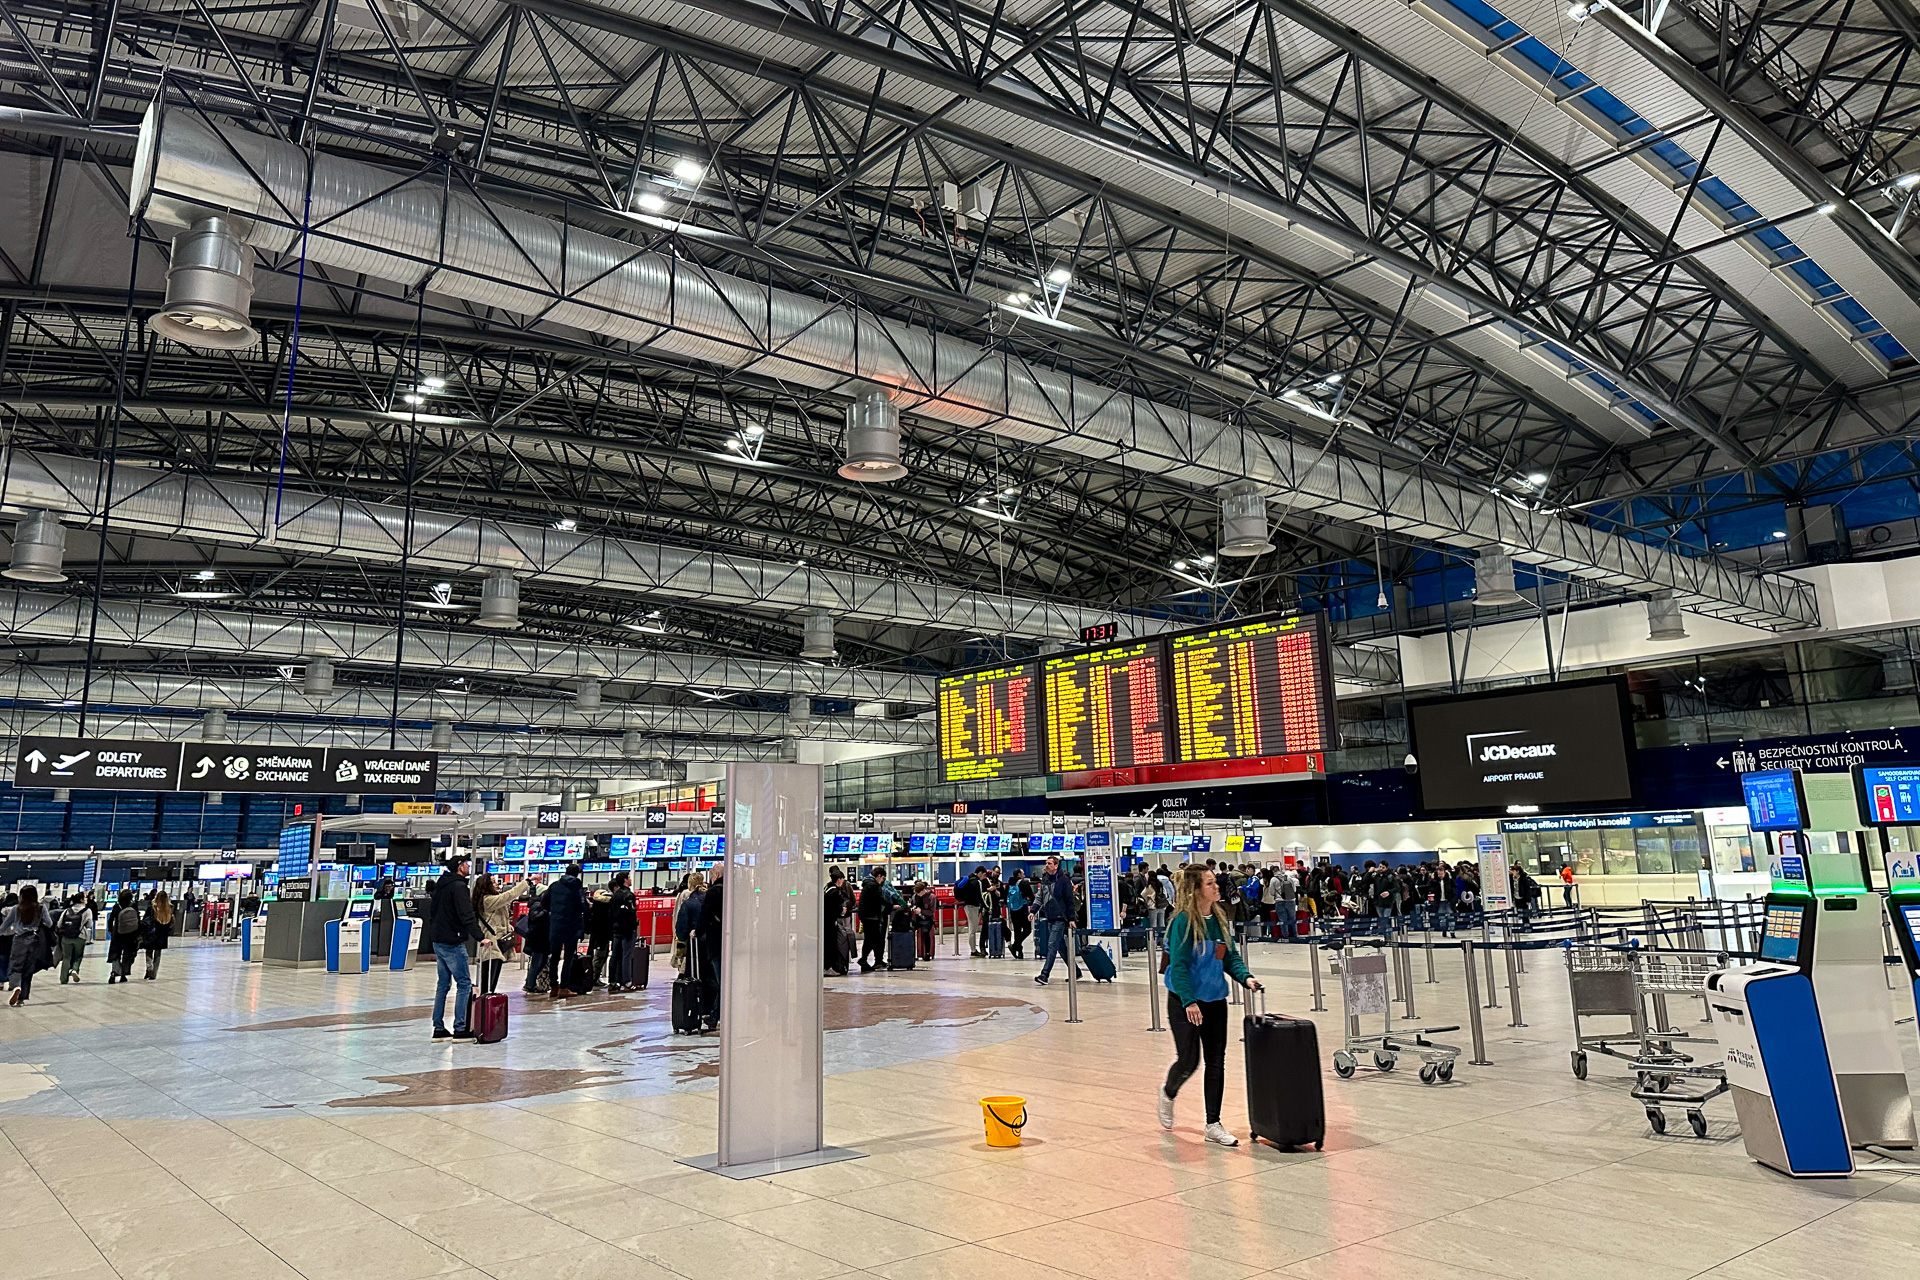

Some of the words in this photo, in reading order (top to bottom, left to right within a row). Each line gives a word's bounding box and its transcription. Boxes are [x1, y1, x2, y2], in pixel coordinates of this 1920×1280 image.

[1086, 625, 1113, 640] 17:31
[1480, 744, 1556, 762] JCDecaux
[1758, 742, 1838, 759] BEZPEČNOSTNÍ
[1841, 738, 1903, 753] KONTROLA
[98, 752, 142, 764] ODLETY
[256, 756, 312, 768] SMĚNÁRNA
[364, 760, 405, 771] VRÁCENÍ
[405, 760, 430, 772] DANĚ
[1761, 758, 1812, 772] SECURITY
[96, 766, 168, 778] DEPARTURES
[255, 770, 309, 782] EXCHANGE
[1483, 774, 1512, 782] AIRPORT
[1514, 772, 1544, 780] PRAGUE
[364, 773, 382, 783] TAX
[384, 774, 420, 784] REFUND
[1162, 798, 1187, 807] ODLETY
[540, 812, 558, 822] 248
[648, 812, 664, 822] 249
[860, 814, 873, 823] 252
[938, 814, 950, 823] 253
[985, 815, 997, 824] 254
[1052, 815, 1064, 824] 255
[1504, 822, 1537, 831] Ticketing
[1538, 820, 1560, 830] office
[1564, 818, 1596, 828] Prodejní
[1597, 816, 1631, 826] kancelář
[1736, 1049, 1753, 1061] Prague
[1739, 1058, 1756, 1069] Airport
